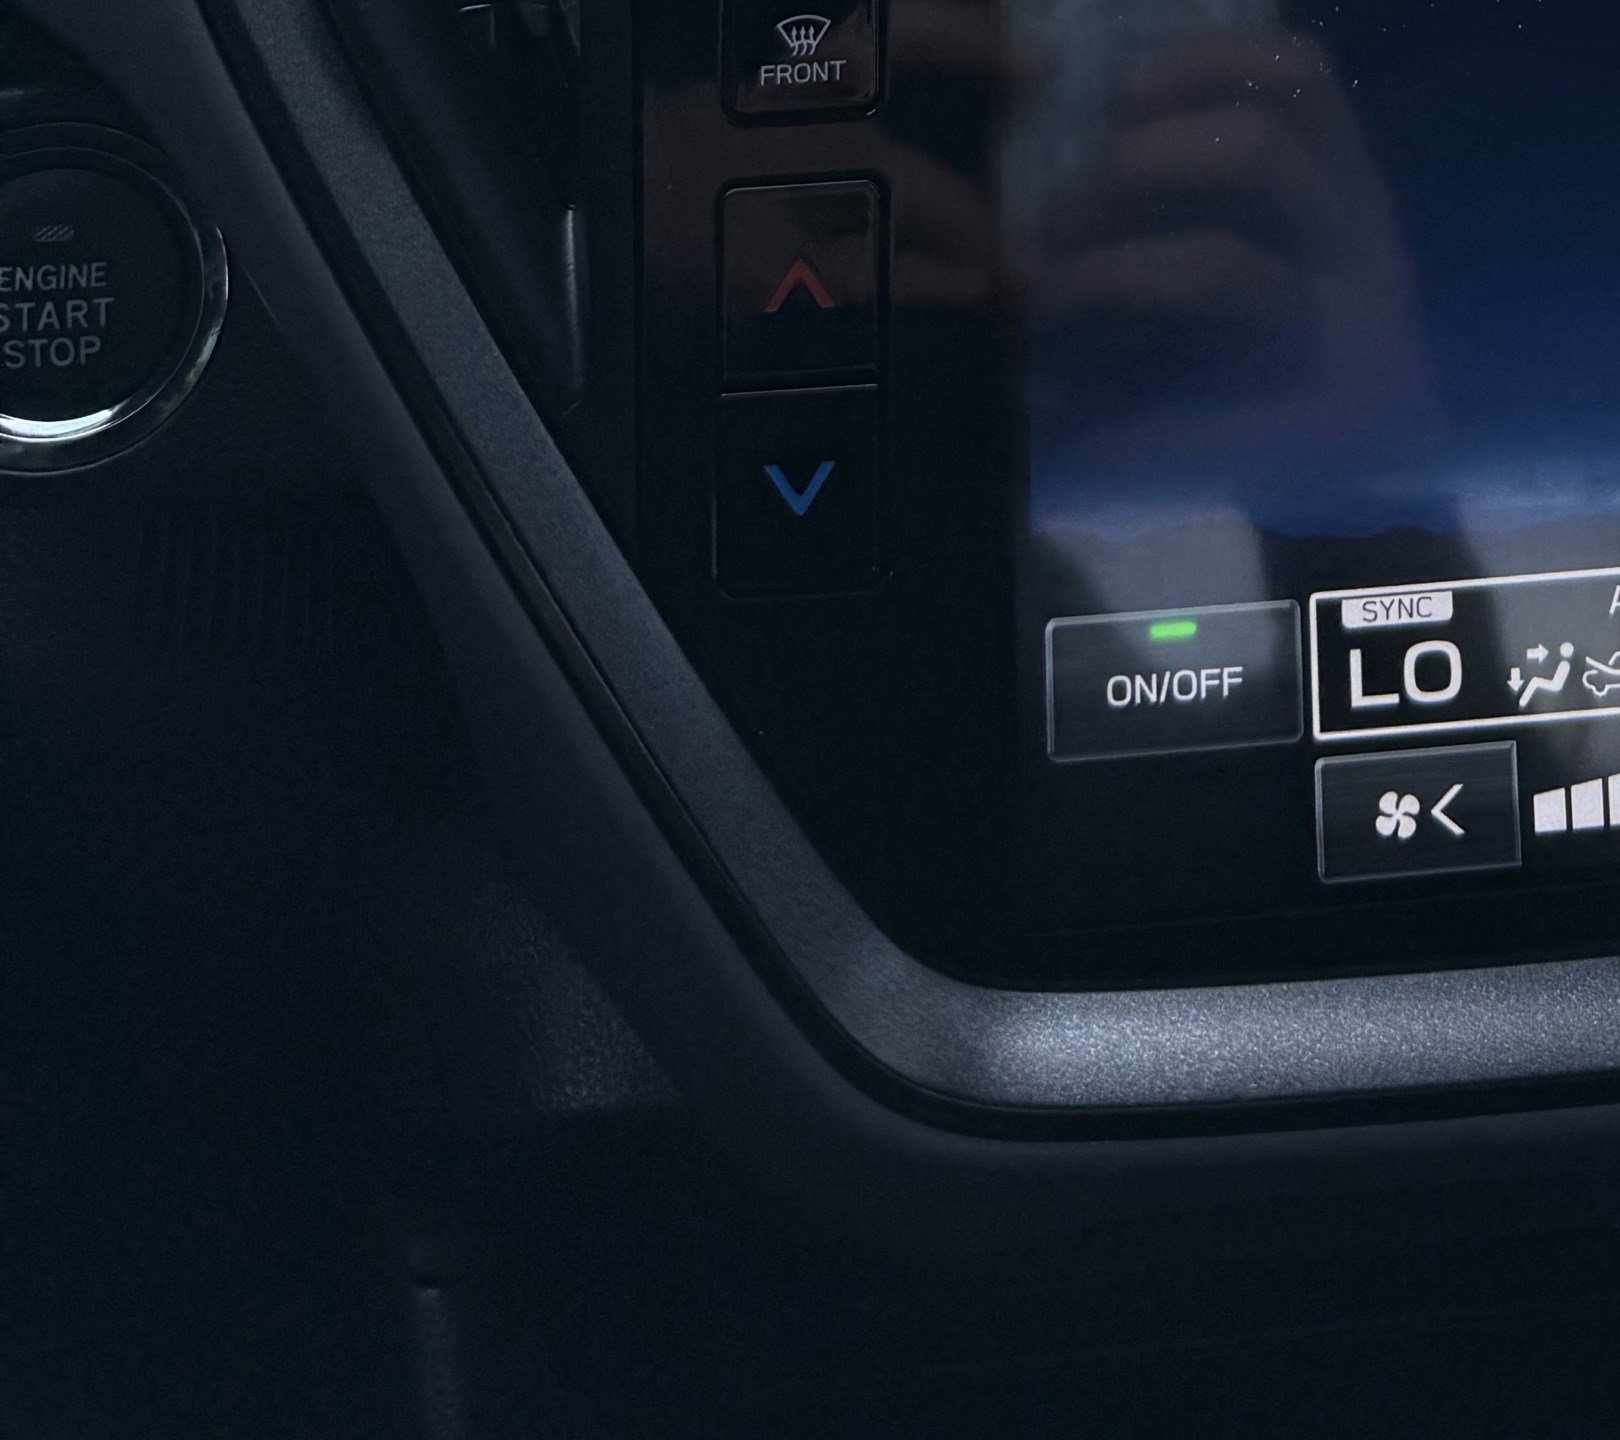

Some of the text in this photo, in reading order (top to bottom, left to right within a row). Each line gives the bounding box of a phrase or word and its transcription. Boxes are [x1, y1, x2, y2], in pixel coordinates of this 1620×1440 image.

[760, 60, 847, 86] FRONT
[0, 261, 108, 291] ENGINE
[3, 335, 101, 369] STOP
[1362, 596, 1433, 623] SYNC
[1106, 666, 1244, 707] ON/OFF
[1349, 639, 1463, 708] LO
